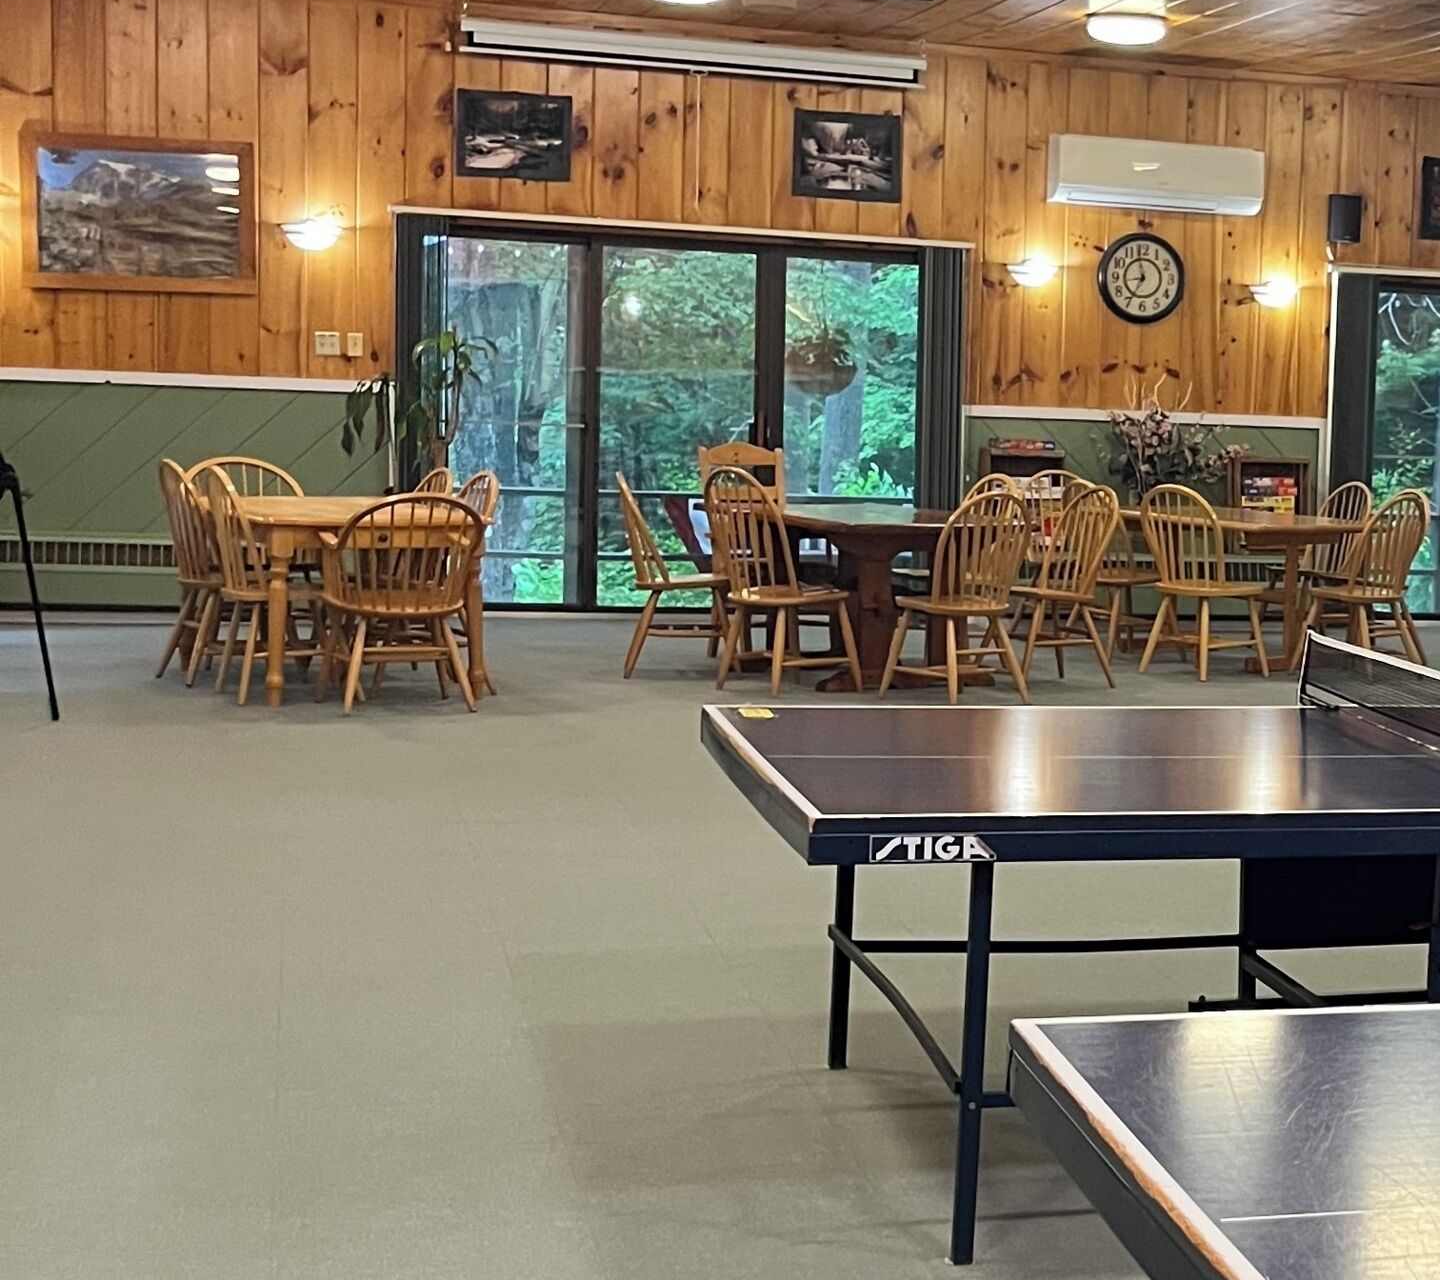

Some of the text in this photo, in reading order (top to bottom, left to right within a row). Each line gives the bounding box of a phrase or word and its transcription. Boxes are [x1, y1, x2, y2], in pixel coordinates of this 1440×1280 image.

[1124, 246, 1134, 259] 11
[1136, 243, 1150, 257] 12
[1154, 249, 1159, 261] 1
[1114, 257, 1126, 269] 10
[1163, 259, 1171, 271] 2
[1111, 272, 1119, 283] 9
[1167, 273, 1175, 285] 3
[1115, 286, 1123, 298] 8
[1163, 288, 1170, 299] 4
[1124, 297, 1133, 308] 7
[1139, 301, 1146, 312] 6
[1152, 298, 1160, 309] 5
[875, 835, 990, 861] STIGA
